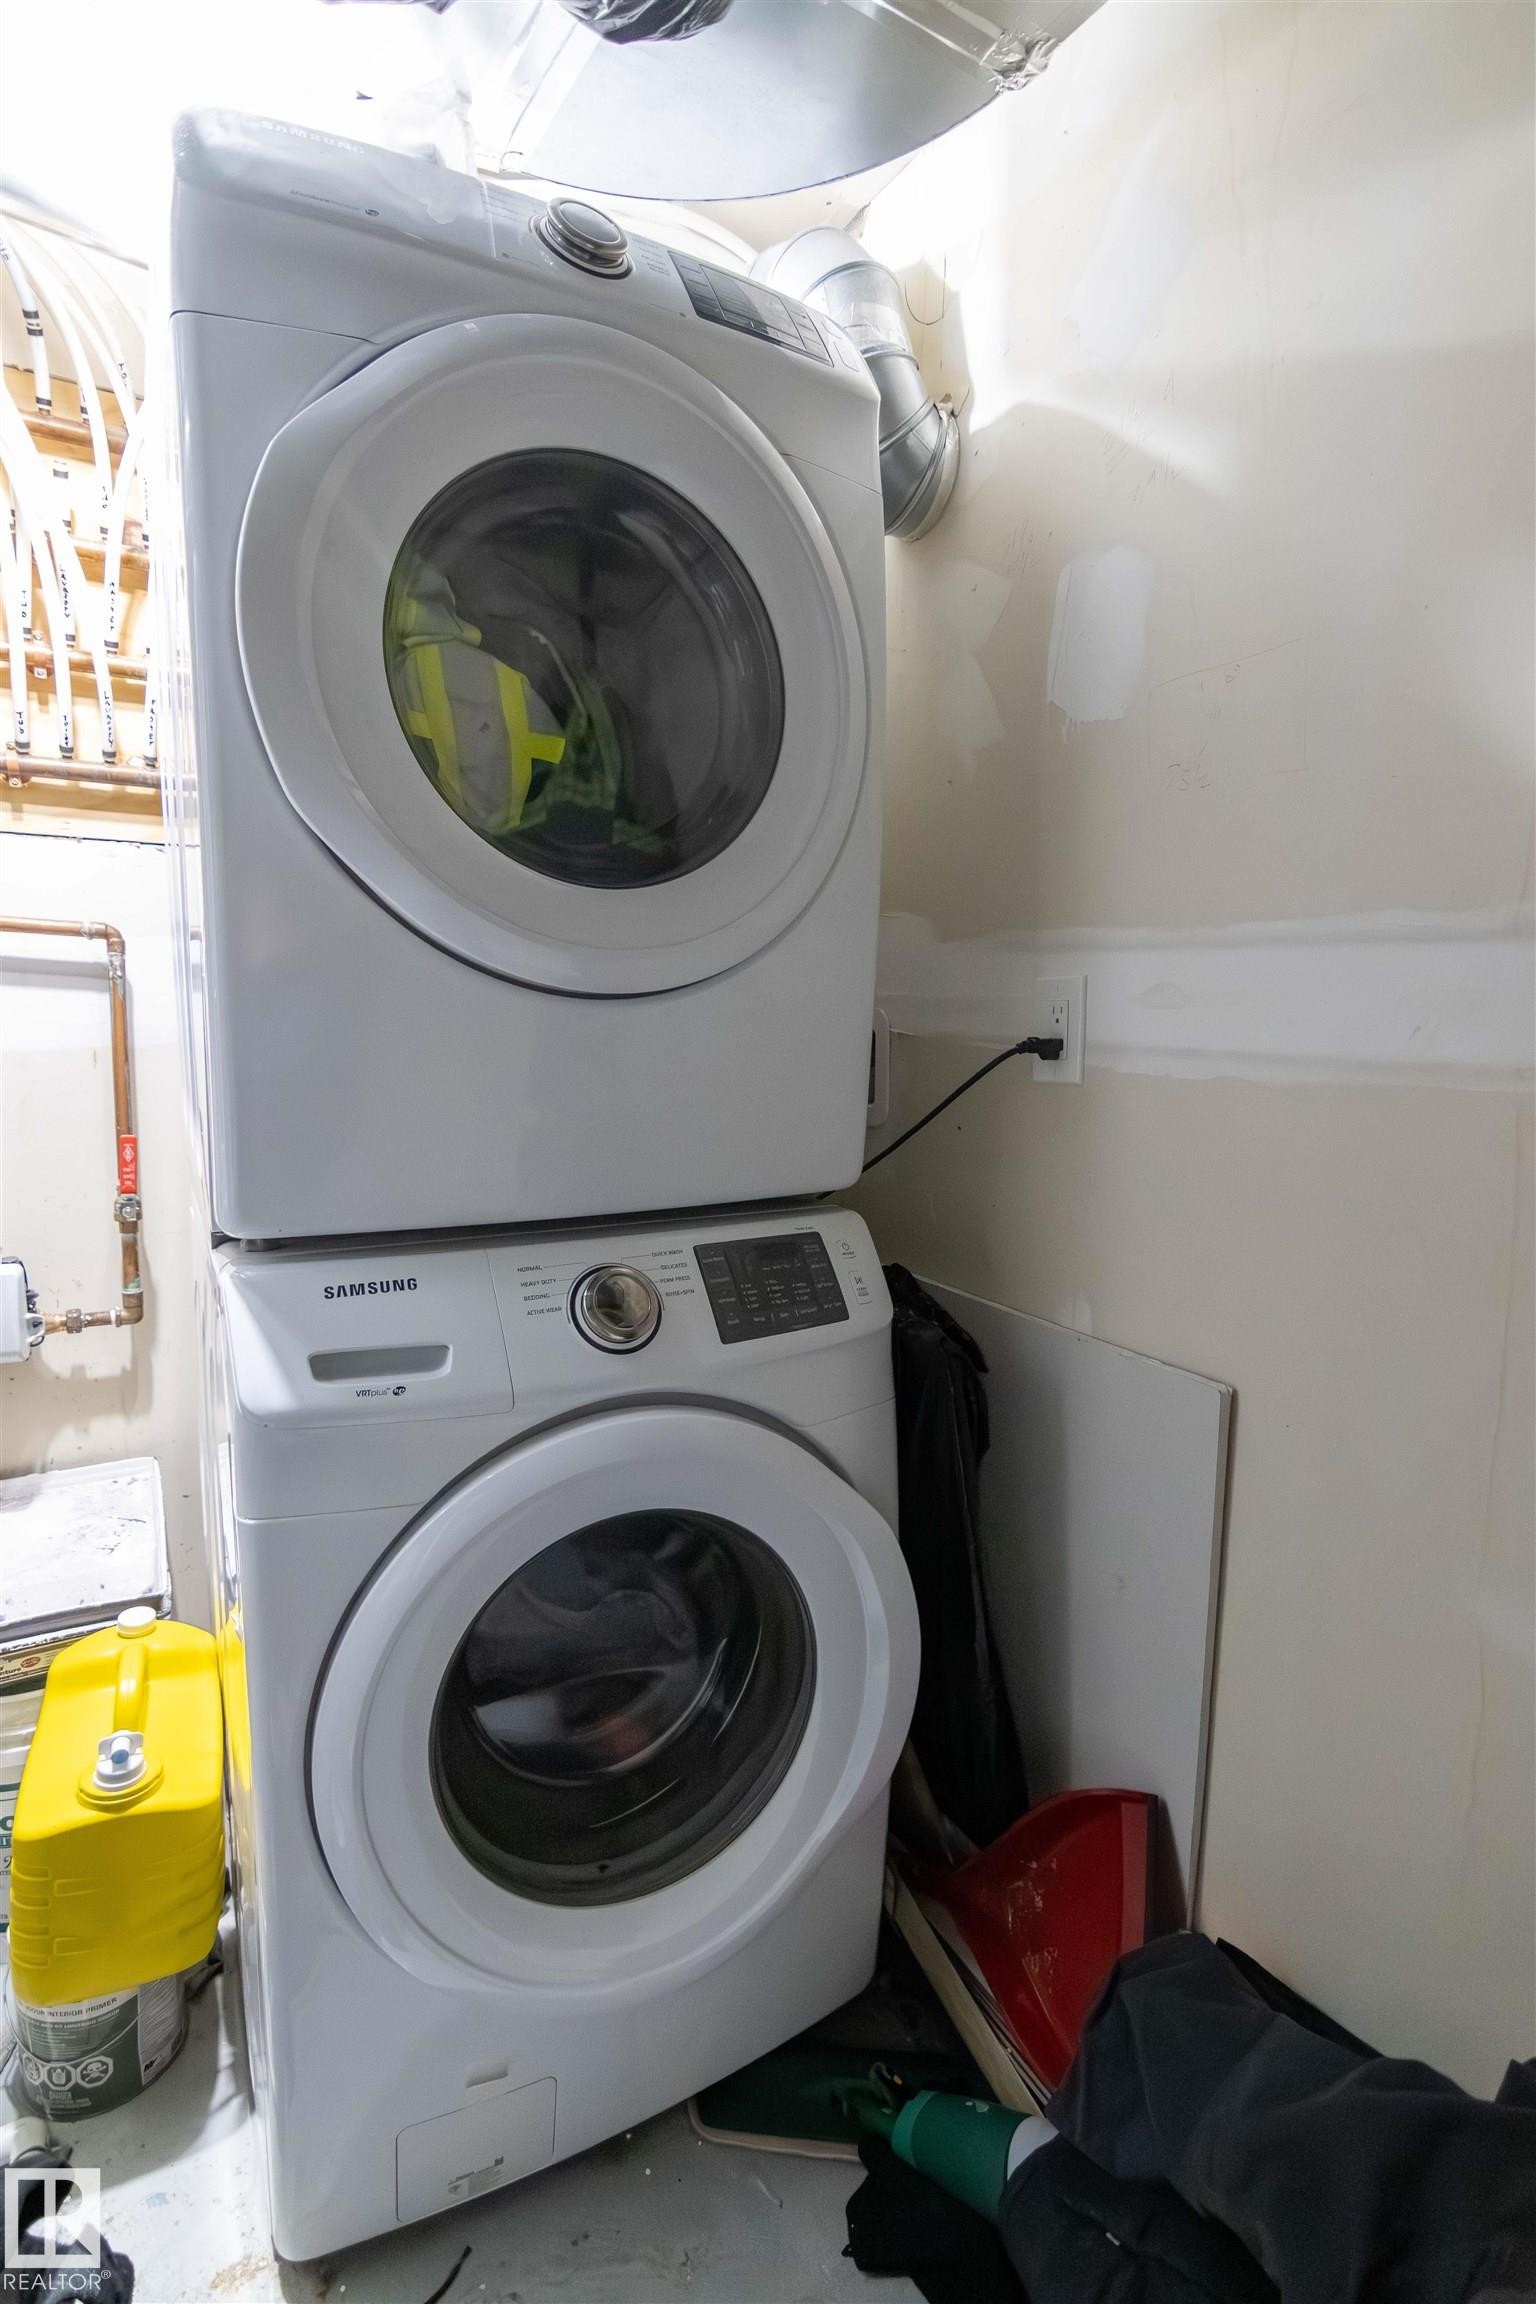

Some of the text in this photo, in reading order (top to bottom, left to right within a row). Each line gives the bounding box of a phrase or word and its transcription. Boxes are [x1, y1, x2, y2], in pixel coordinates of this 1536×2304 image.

[517, 1264, 542, 1272] NORMAL
[660, 1262, 688, 1271] DELICATES
[520, 1278, 557, 1288] HEAVY DUTY
[324, 1278, 418, 1300] SAMSUNG
[523, 1293, 551, 1302] BEDDING
[526, 1305, 562, 1316] ACTIVE WEAR
[85, 1996, 118, 2015] PRIMER
